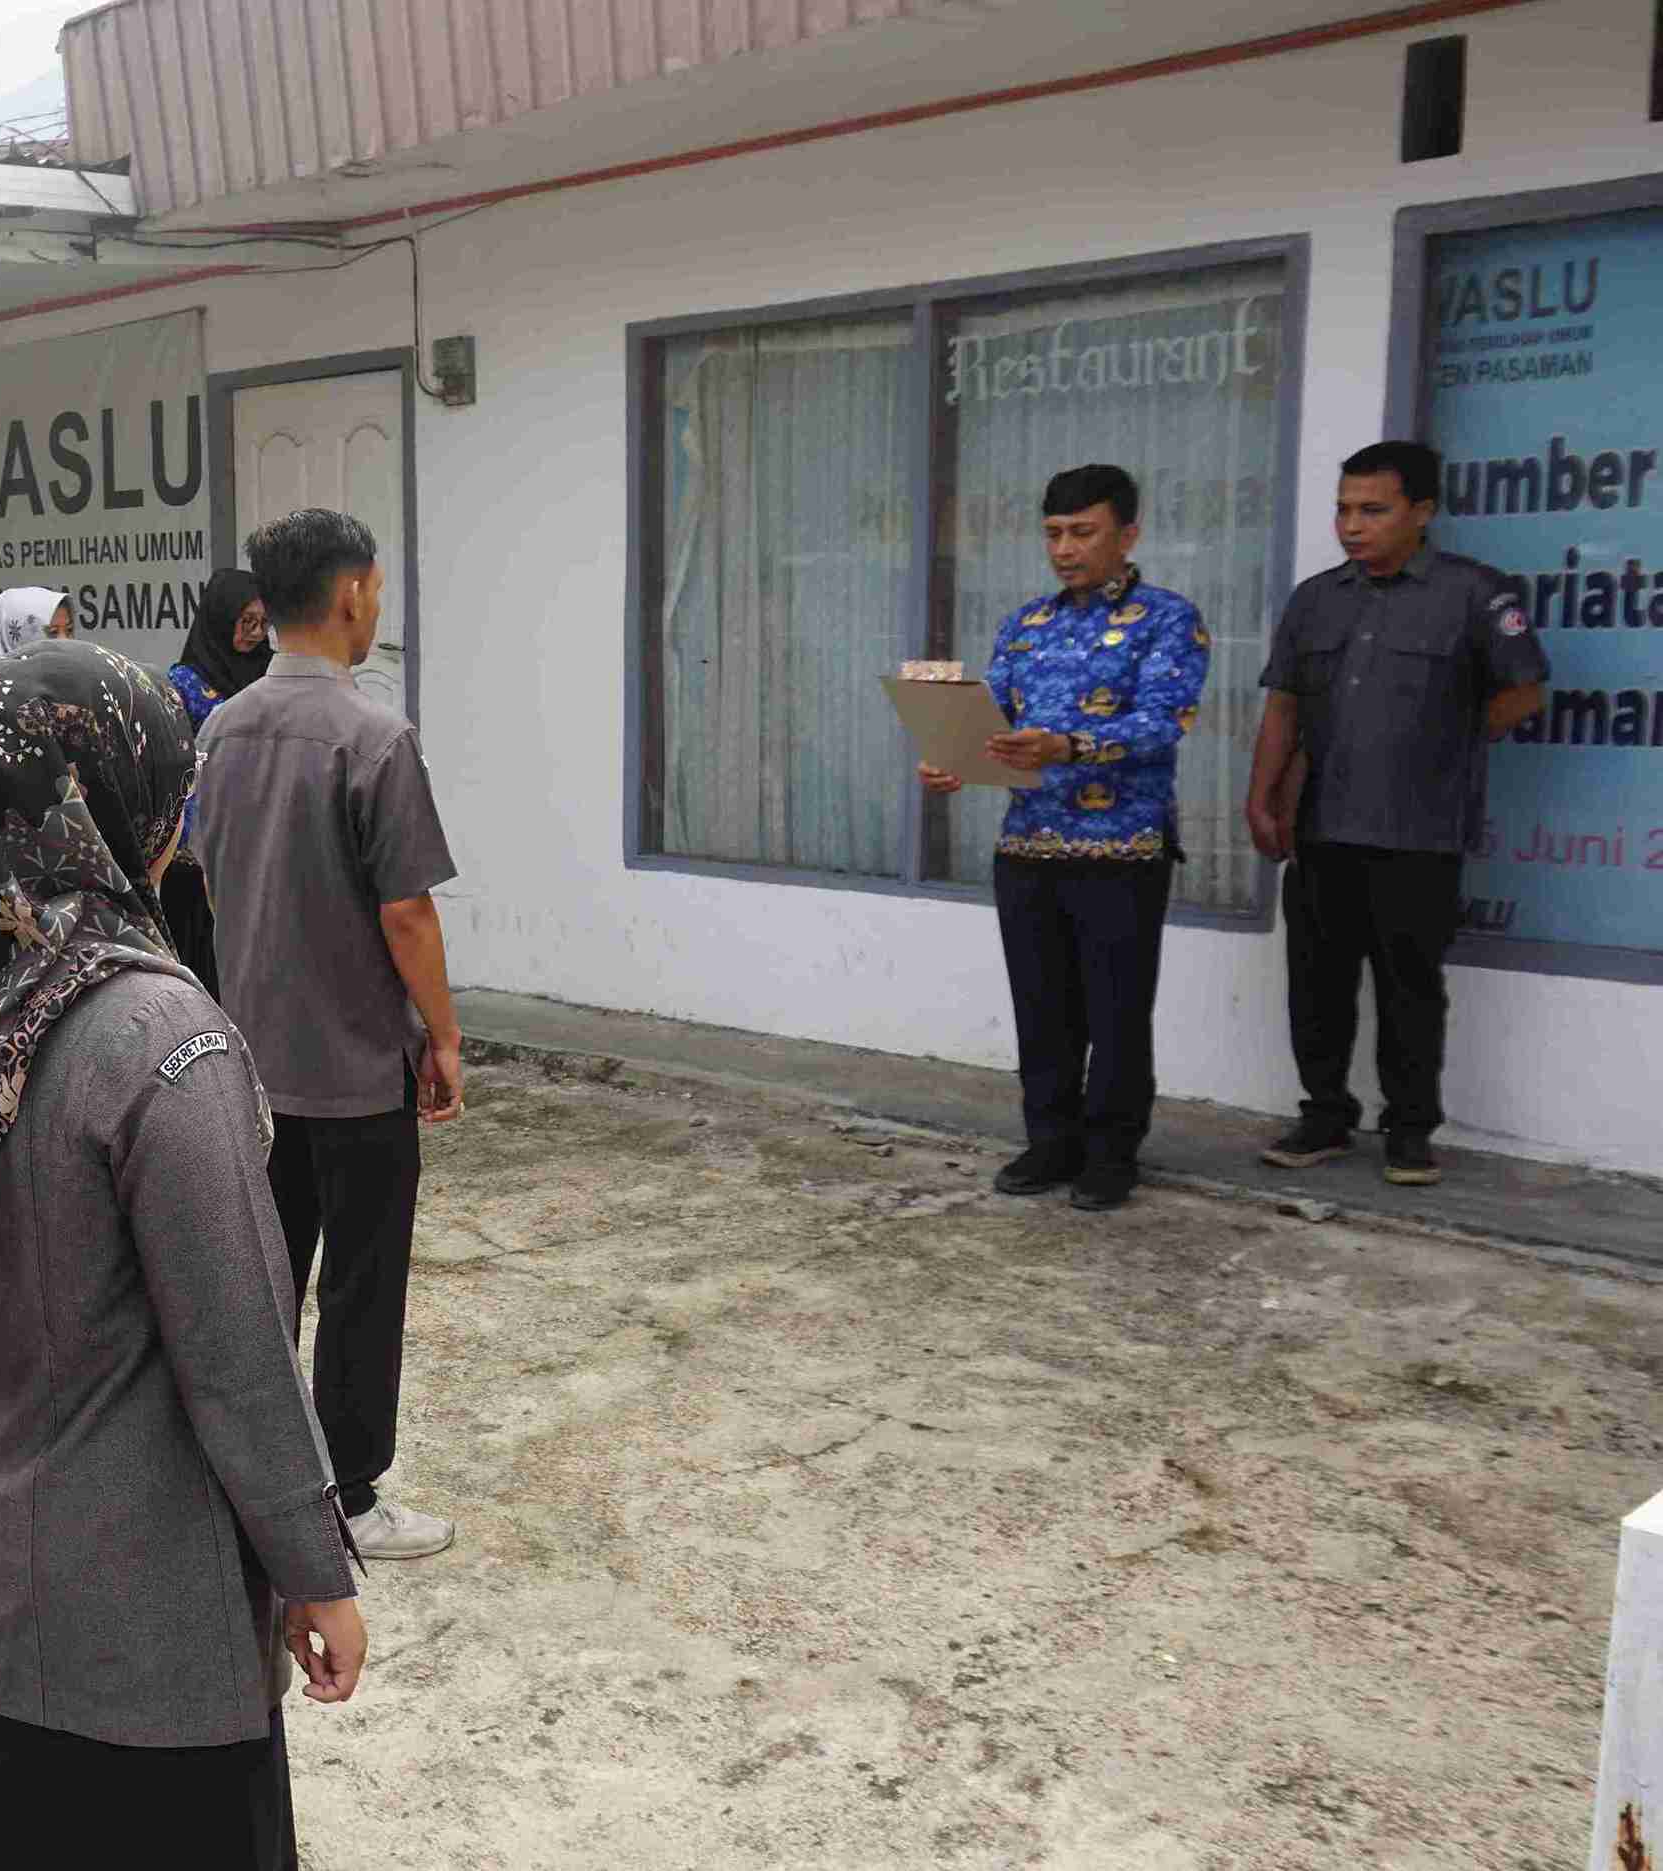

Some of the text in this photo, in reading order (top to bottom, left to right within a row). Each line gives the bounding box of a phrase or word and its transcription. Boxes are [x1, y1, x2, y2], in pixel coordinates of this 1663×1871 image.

[945, 297, 1263, 405] Restaurant
[1475, 350, 1593, 384] PASAMAN
[21, 535, 130, 568] PEMILIHAN
[137, 530, 204, 562] UMUM
[61, 581, 209, 631] SAMAN
[1511, 822, 1627, 866] Juni
[164, 1035, 225, 1075] SEKRETARIAT
